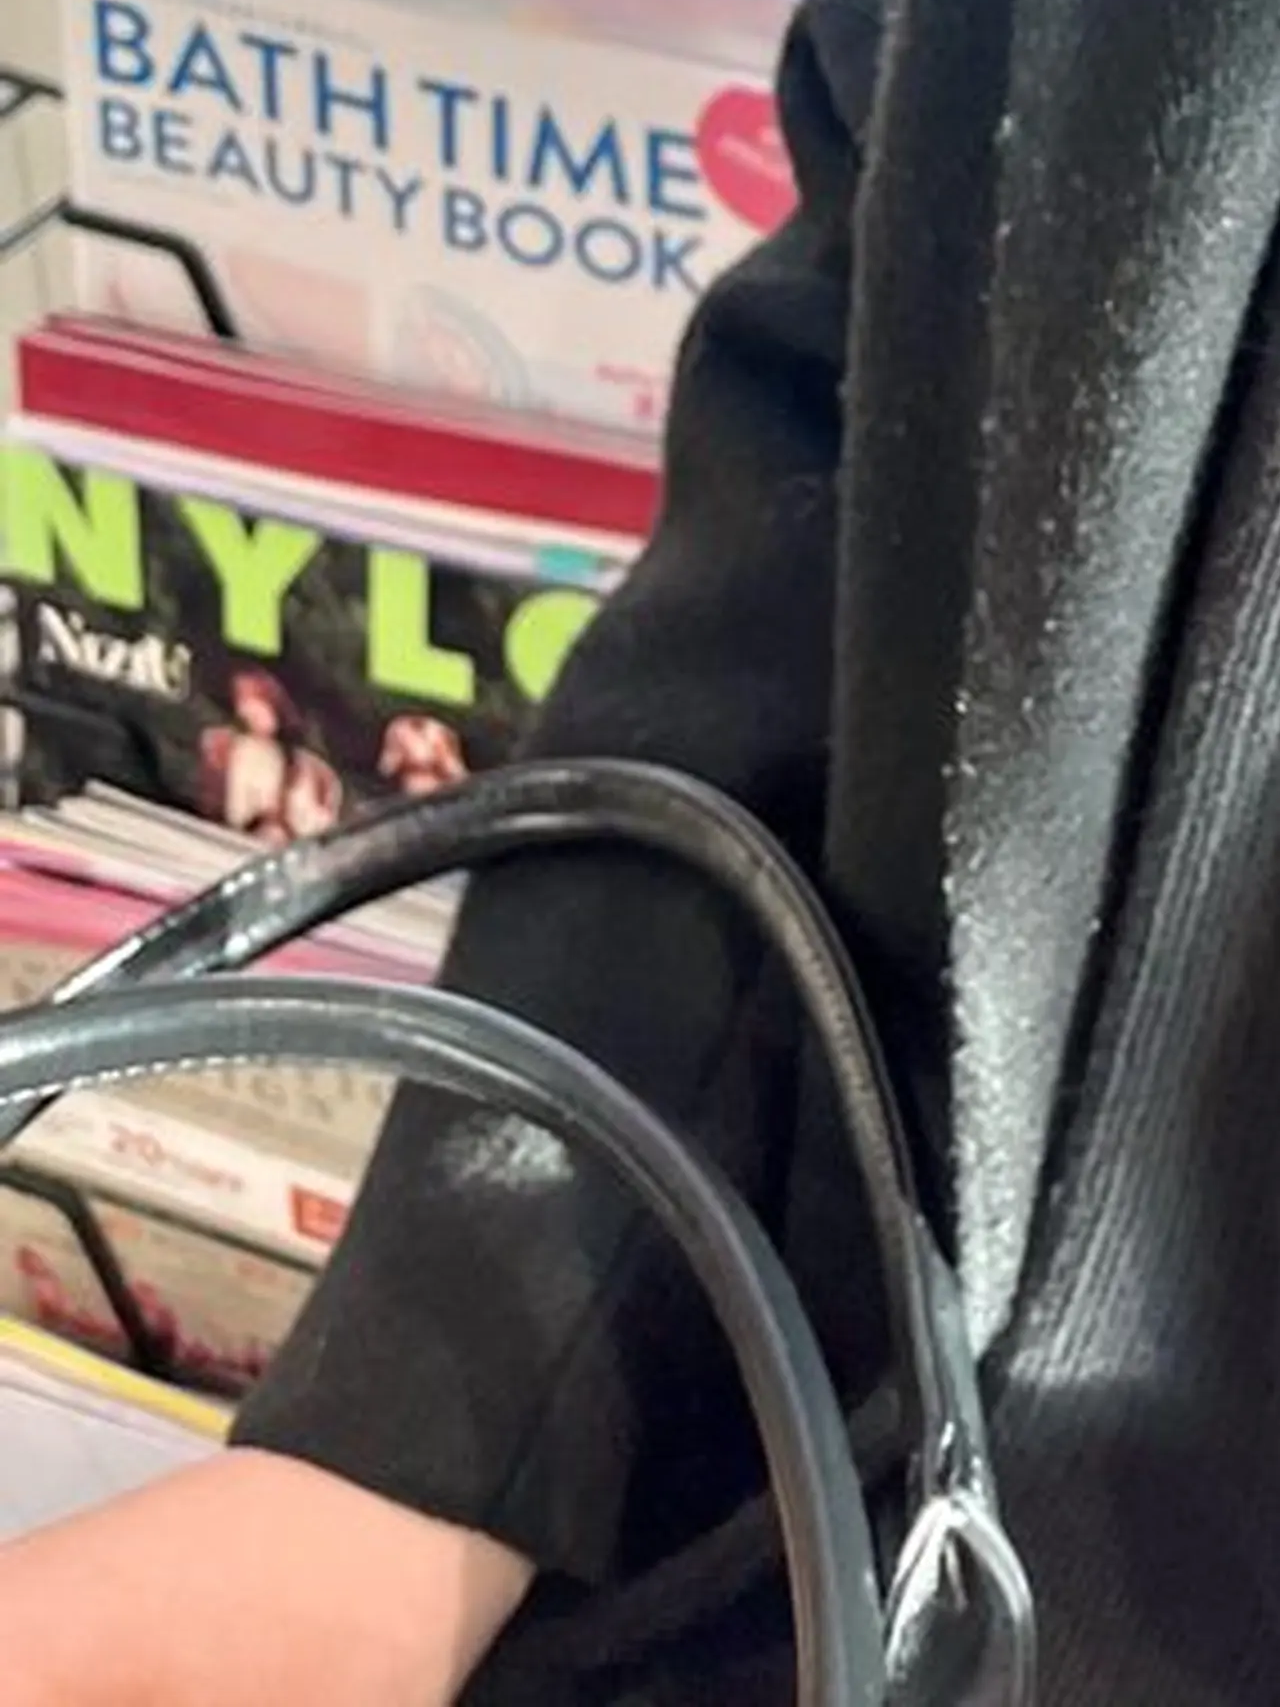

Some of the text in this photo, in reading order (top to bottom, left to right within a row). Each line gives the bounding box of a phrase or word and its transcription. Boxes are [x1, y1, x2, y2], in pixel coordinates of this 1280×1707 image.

[99, 97, 704, 298] BEAUTY BOOK
[416, 75, 707, 222] TIME
